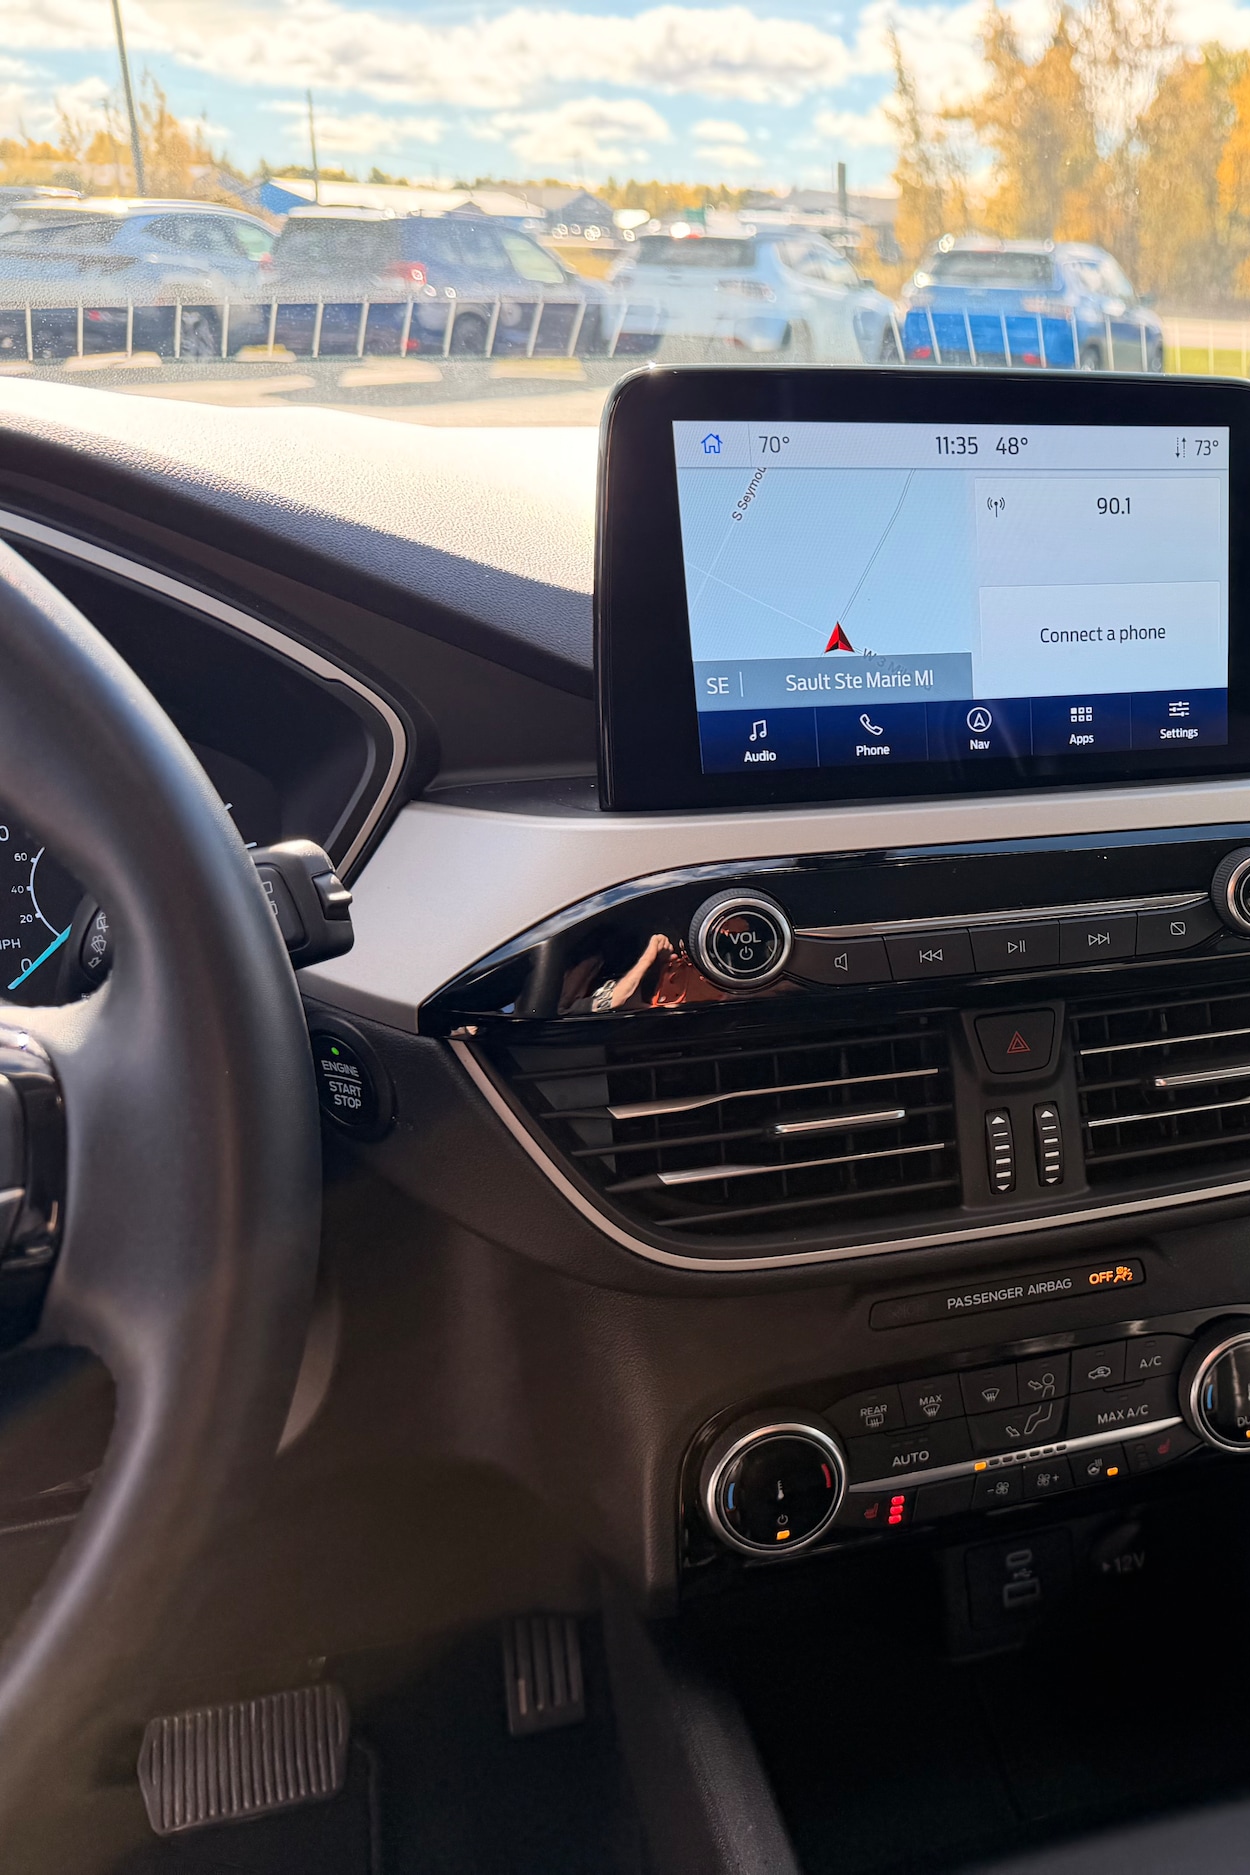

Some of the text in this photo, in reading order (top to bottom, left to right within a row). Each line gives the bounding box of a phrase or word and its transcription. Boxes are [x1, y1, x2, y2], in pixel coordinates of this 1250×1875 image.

[758, 435, 790, 454] 70°
[935, 436, 1029, 455] 11:35 48°
[1194, 439, 1219, 457] 73°
[1096, 497, 1132, 515] 90.1
[731, 510, 744, 522] S
[1039, 624, 1167, 644] Connect a phone
[706, 677, 730, 694] SE
[785, 673, 831, 692] Sault
[834, 671, 863, 690] Ste
[866, 671, 911, 688] Marie
[915, 669, 934, 686] MI
[1069, 733, 1094, 746] Apps
[1159, 728, 1199, 741] Settings
[855, 744, 891, 757] Phone
[969, 739, 991, 750] Nav
[743, 749, 777, 763] Audio
[14, 852, 28, 862] 60
[11, 884, 25, 894] 40
[20, 914, 33, 924] 20
[0, 937, 21, 950] PH
[729, 931, 762, 945] VOL
[321, 1060, 359, 1077] ENGINE
[328, 1081, 361, 1097] START
[334, 1094, 361, 1109] STOP
[946, 1286, 1024, 1310] PASSENGER
[1027, 1278, 1073, 1296] AIRBAG
[1088, 1270, 1114, 1285] OFF
[1139, 1355, 1162, 1369] A/C
[919, 1394, 943, 1406] MAX
[860, 1404, 888, 1417] REAR
[1097, 1404, 1149, 1425] MAX A/C
[892, 1450, 930, 1467] AUTO
